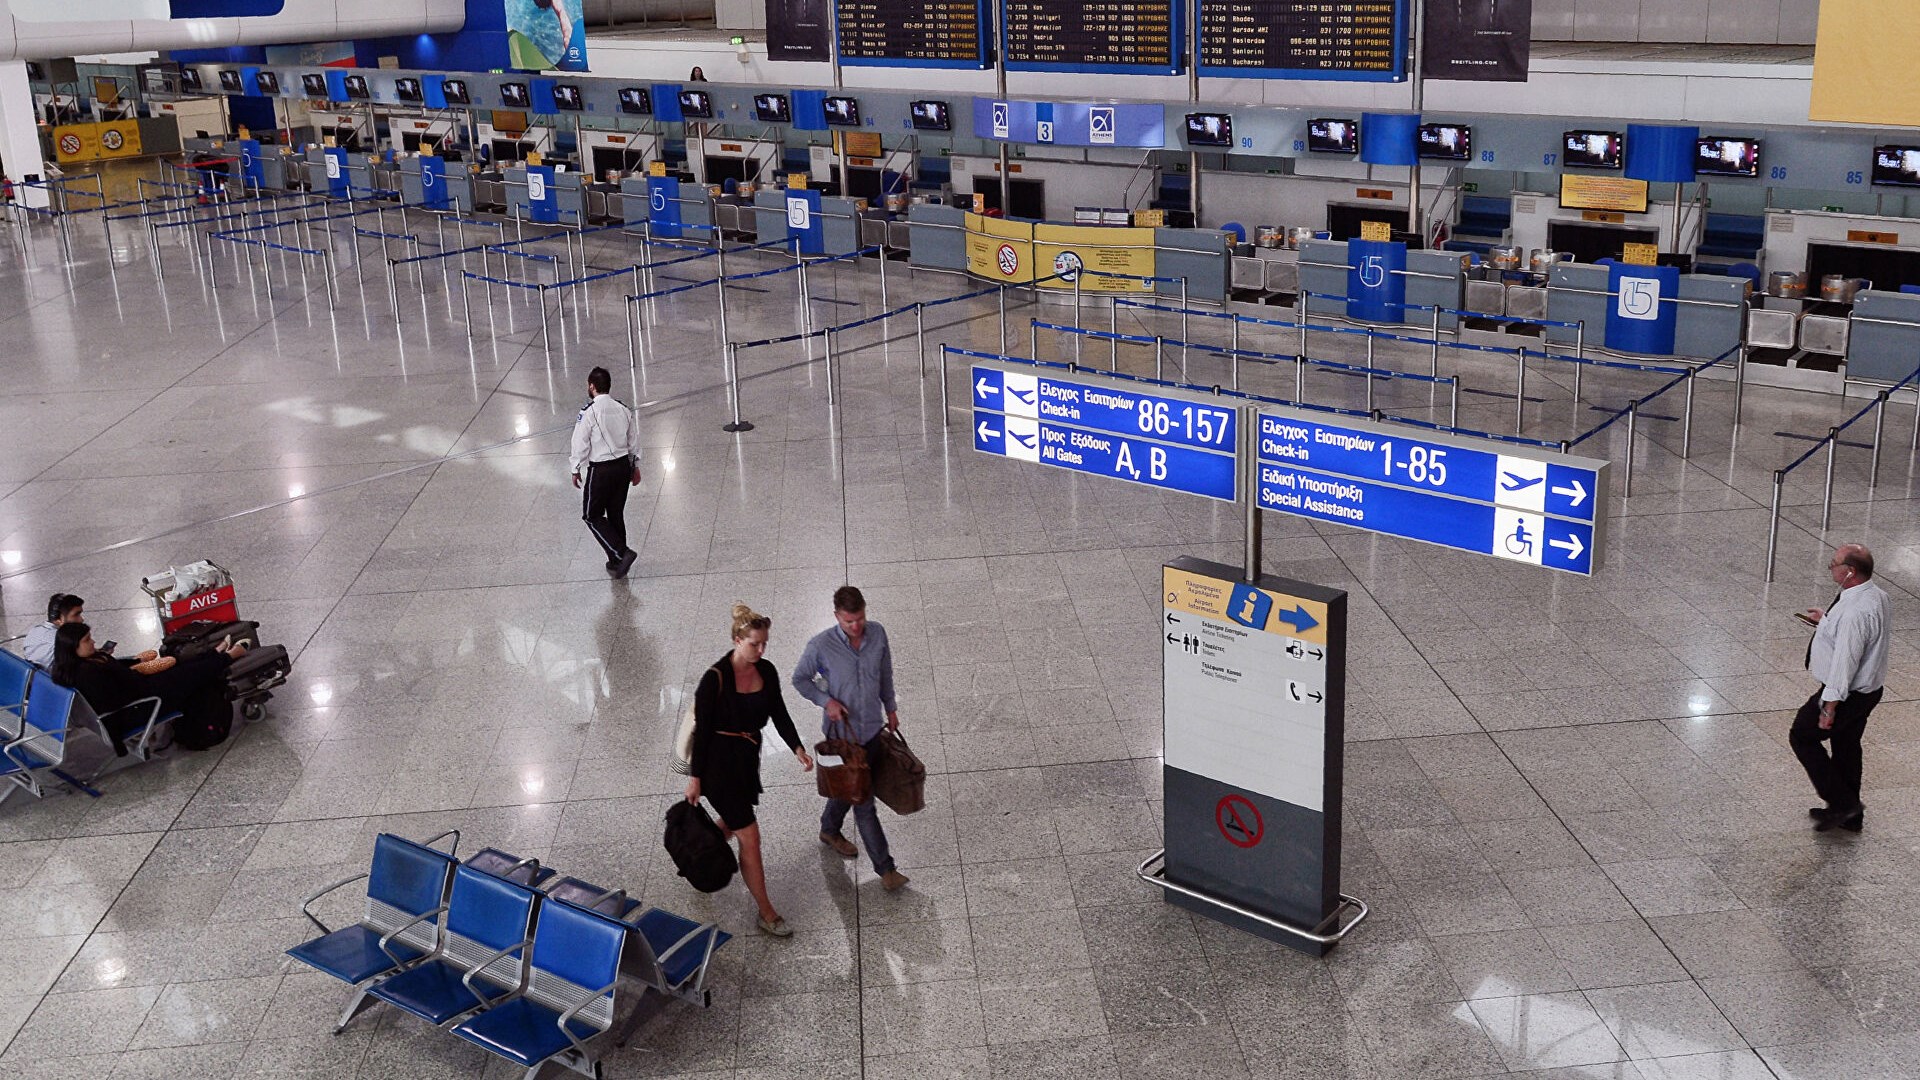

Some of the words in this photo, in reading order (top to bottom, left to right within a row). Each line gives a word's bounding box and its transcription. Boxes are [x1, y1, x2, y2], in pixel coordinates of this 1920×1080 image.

[903, 119, 911, 128] 93
[1042, 124, 1049, 140] 3
[1242, 137, 1252, 148] 90
[1293, 140, 1304, 151] 89
[1482, 150, 1494, 162] 88
[1543, 153, 1557, 166] 87
[1771, 166, 1787, 180] 86
[1846, 171, 1863, 184] 85
[1359, 254, 1384, 288] 15
[1623, 280, 1652, 315] 15
[1040, 382, 1078, 403] Ελεγχος
[1084, 390, 1135, 410] Εισιτηρίων
[1041, 400, 1080, 419] Check-in
[1138, 399, 1229, 444] 86-157
[1042, 427, 1066, 445] Προς
[1071, 432, 1110, 454] Εξόδους
[1262, 419, 1308, 442] Ελεγχος
[1315, 428, 1375, 452] Εισιτηρίων
[1042, 446, 1055, 459] All
[1057, 448, 1082, 464] Gates
[1262, 439, 1309, 460] Check-in
[1115, 442, 1141, 480] A,
[1150, 447, 1167, 481] B
[1380, 441, 1447, 486] 1-85
[1262, 468, 1296, 490] Ειδική
[1298, 474, 1362, 503] Υποστήριξη
[1262, 488, 1302, 510] Special
[1304, 498, 1364, 521] Assistance
[190, 592, 218, 610] AVIS
[1188, 603, 1220, 614] Information
[1195, 599, 1213, 607] Airport
[1201, 669, 1214, 678] Public
